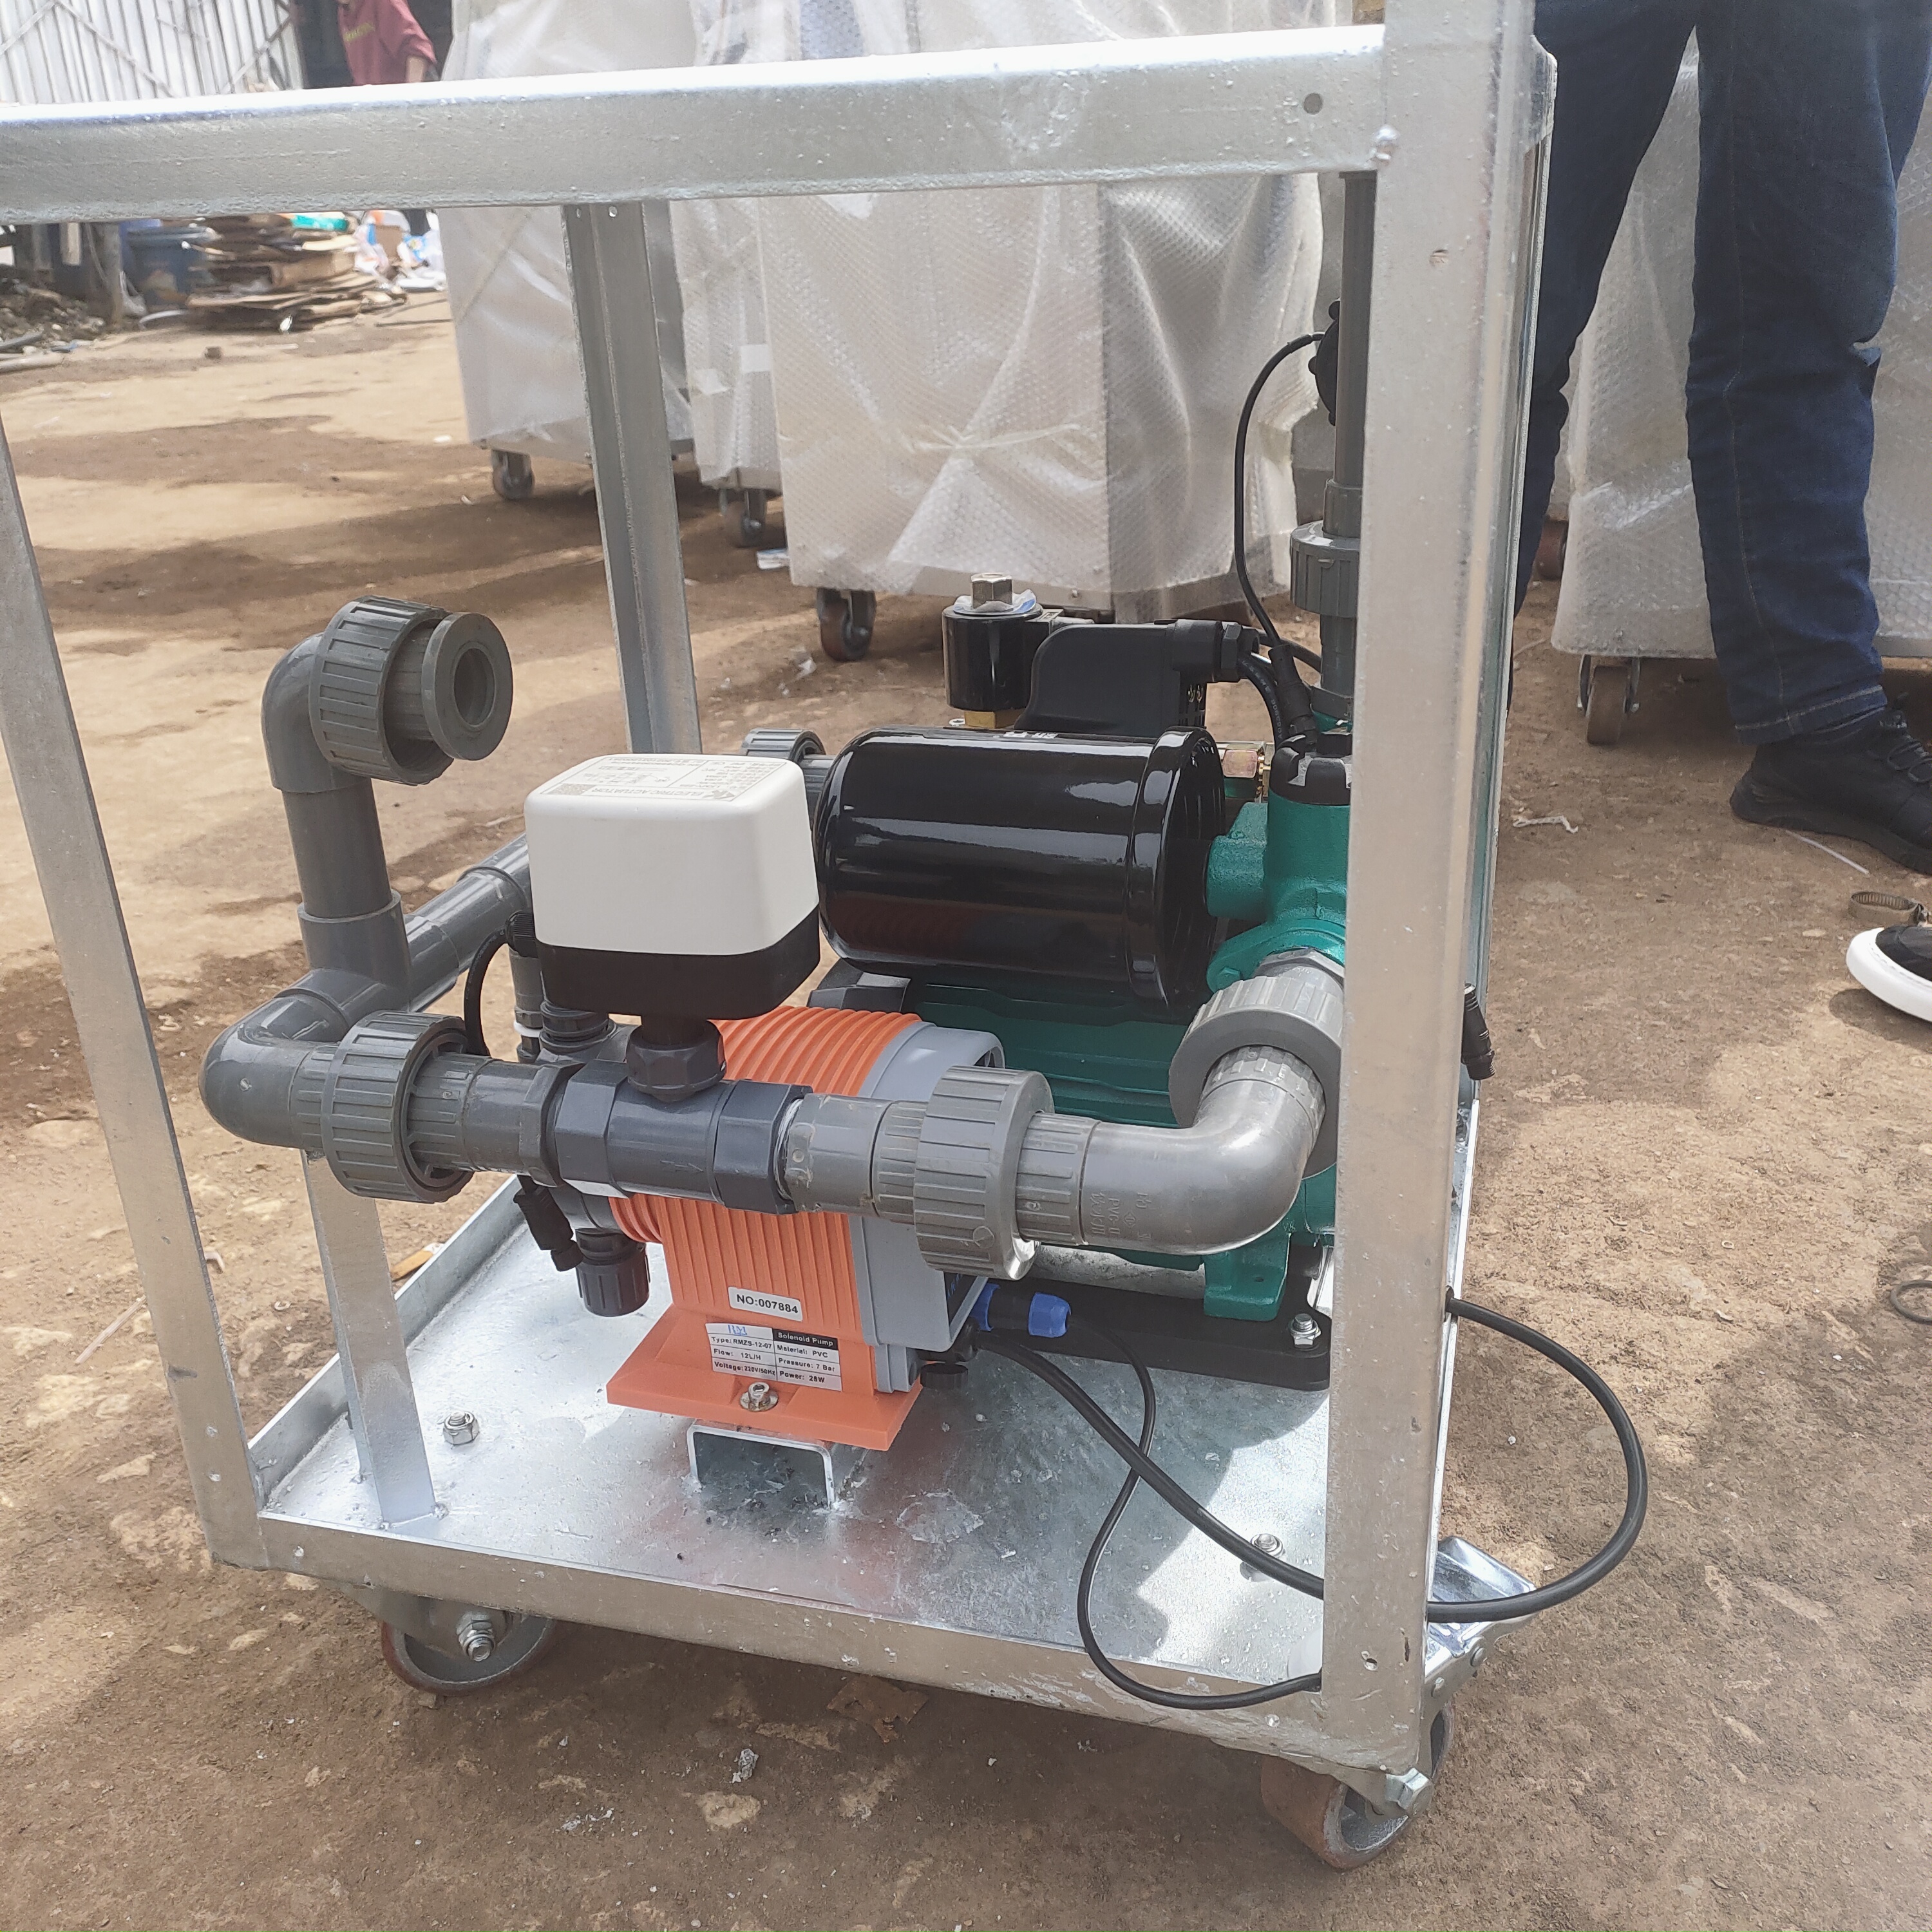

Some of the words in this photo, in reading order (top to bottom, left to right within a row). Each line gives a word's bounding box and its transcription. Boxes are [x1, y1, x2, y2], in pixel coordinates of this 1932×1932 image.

[736, 1294, 799, 1314] NO:007884
[777, 1332, 810, 1343] Solenoid
[812, 1337, 833, 1347] Pump
[714, 1348, 734, 1356] Flow:
[777, 1344, 808, 1355] Material:
[812, 1350, 828, 1358] PVC
[778, 1357, 813, 1368] Pressure:
[779, 1370, 805, 1380] Power:
